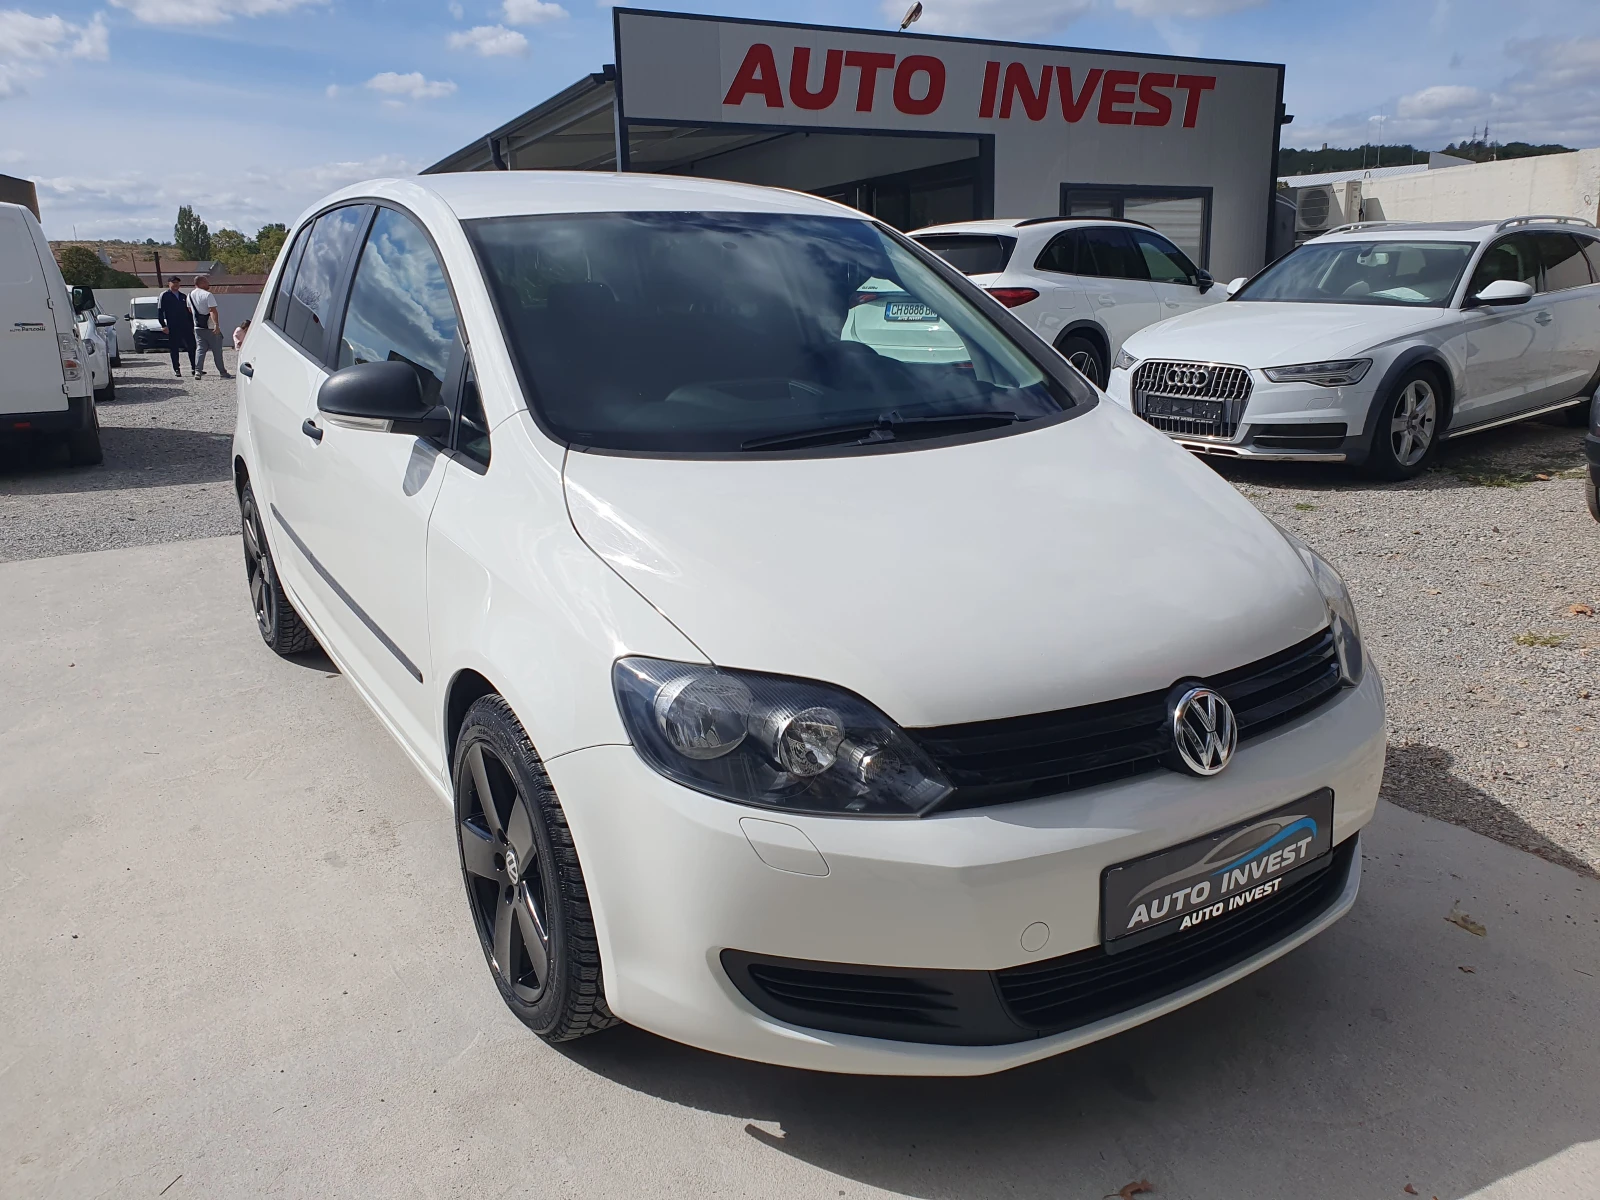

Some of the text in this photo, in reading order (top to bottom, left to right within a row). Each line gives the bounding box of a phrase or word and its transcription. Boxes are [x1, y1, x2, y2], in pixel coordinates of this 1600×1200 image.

[722, 43, 1217, 129] AUTO INVEST
[891, 304, 904, 316] CH
[903, 304, 925, 316] 8888
[1127, 836, 1313, 929] AUTO INVEST
[1179, 878, 1282, 931] AUTO INVEST
